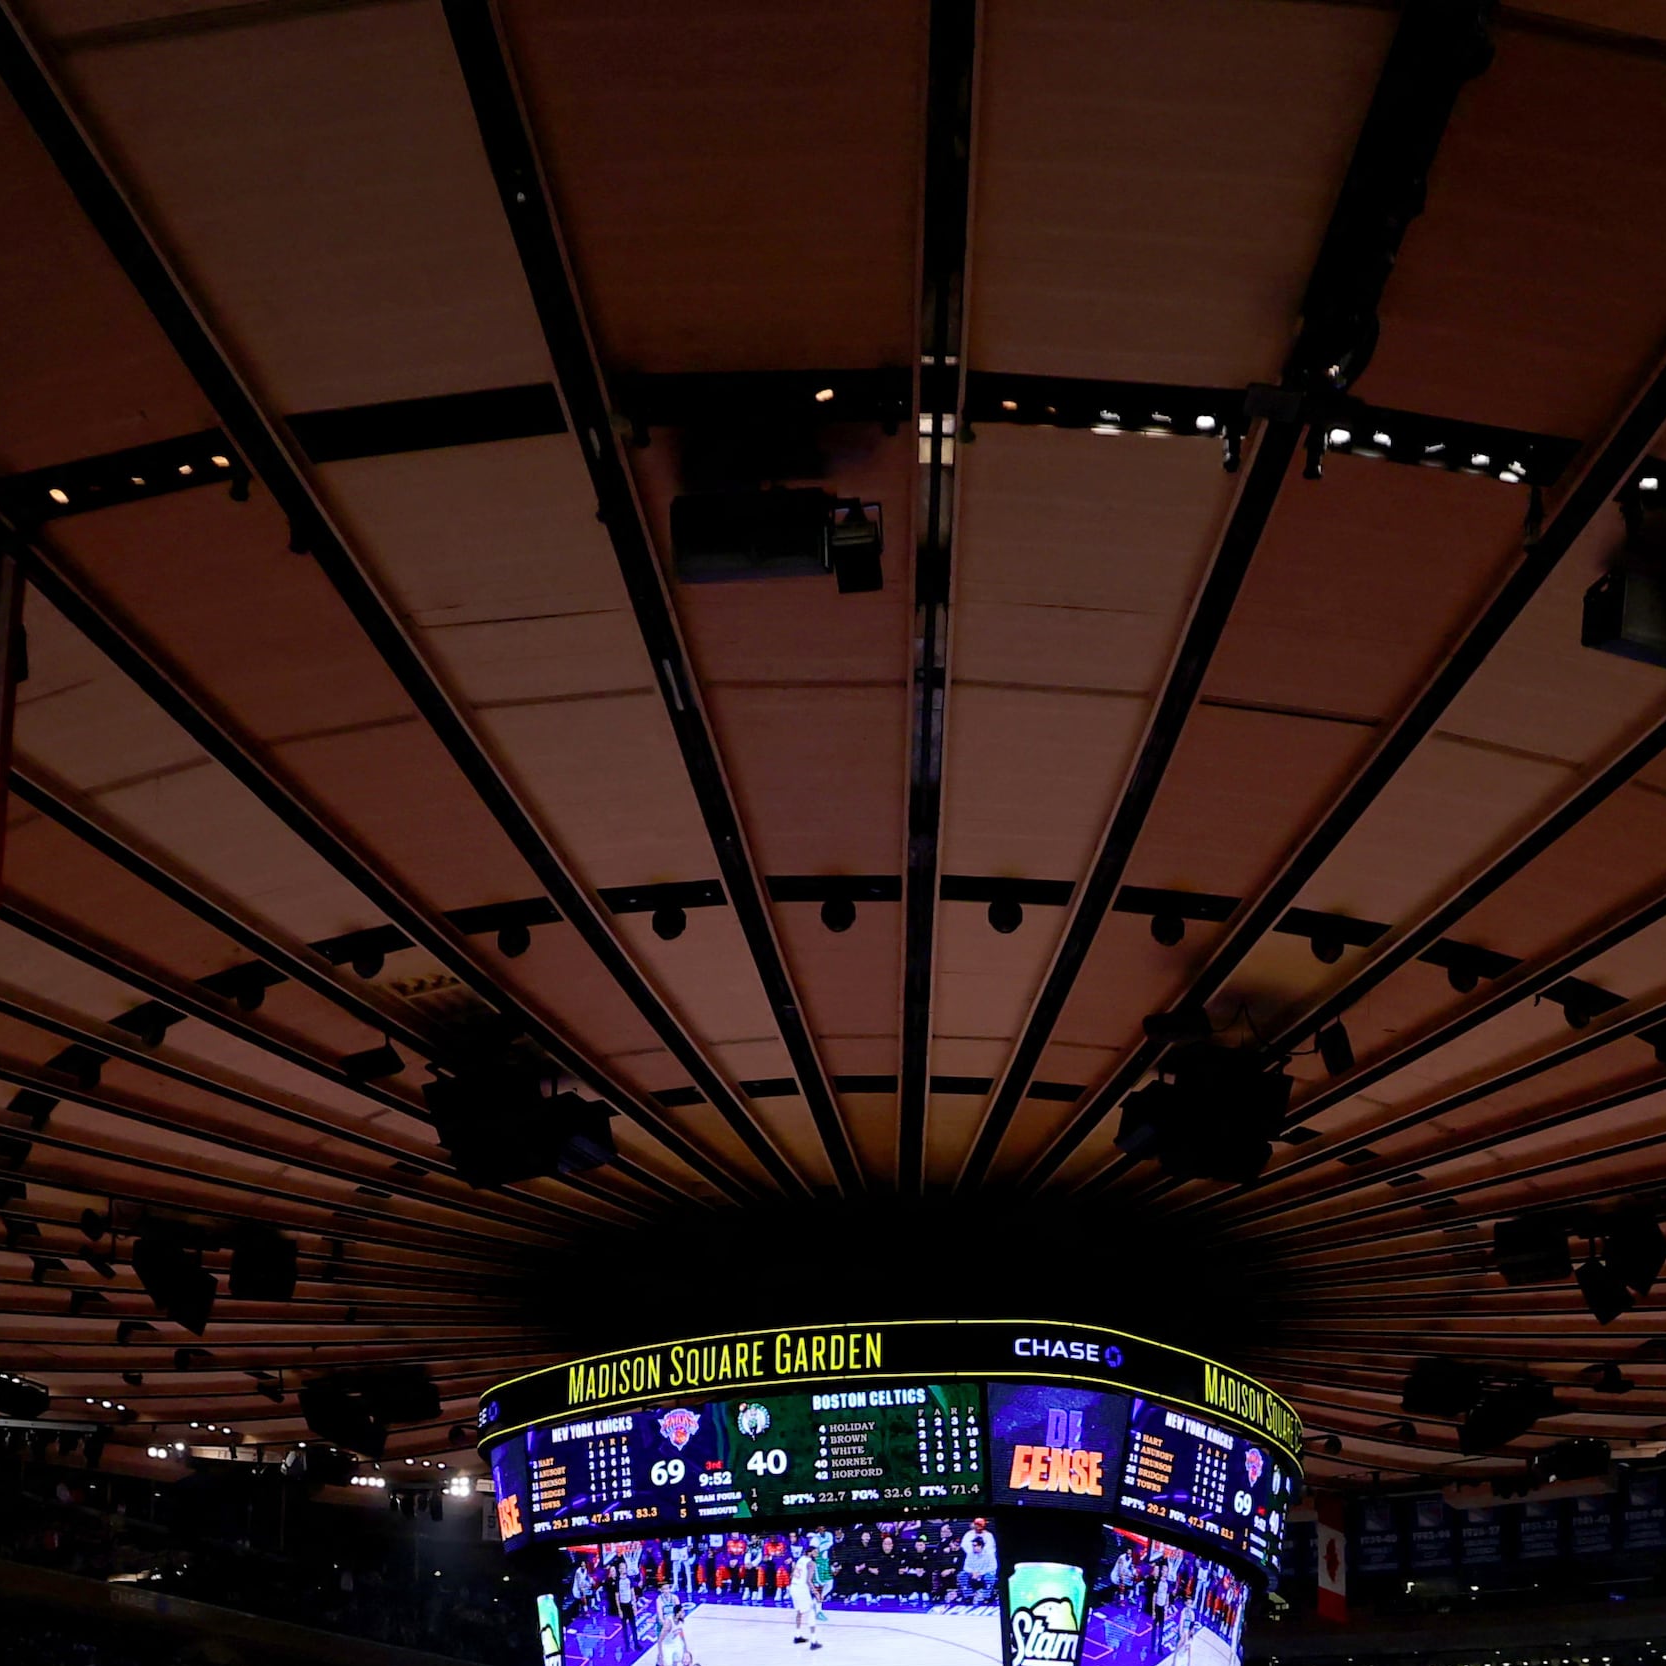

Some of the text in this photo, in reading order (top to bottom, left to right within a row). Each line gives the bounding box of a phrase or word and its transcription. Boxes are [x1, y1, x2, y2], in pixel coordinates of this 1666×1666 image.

[1015, 1338, 1100, 1362] CHASE
[568, 1332, 882, 1405] MADISON SQUARE GARDEN
[813, 1388, 926, 1411] BOSTON CELTICS
[1204, 1364, 1264, 1424] MADISON
[552, 1416, 633, 1443] NEW YORK KNICKS
[830, 1416, 975, 1433] HOLIDAY 2 2 3 4
[1046, 1408, 1082, 1449] DE
[1165, 1412, 1233, 1450] NEW YORK KNICKS
[830, 1434, 867, 1444] BROWN
[919, 1430, 926, 1439] 2
[935, 1429, 942, 1438] 4
[1143, 1434, 1163, 1447] HART
[831, 1440, 959, 1456] WHITE 2 1 1
[706, 1461, 723, 1470] 3rd
[747, 1449, 787, 1476] 40
[832, 1457, 874, 1467] KORNET
[920, 1453, 927, 1462] 2
[936, 1452, 944, 1461] 0
[651, 1459, 685, 1486] 69
[699, 1472, 732, 1486] 9:52
[833, 1468, 882, 1479] HORFORD
[921, 1465, 928, 1474] 1
[937, 1464, 945, 1472] 0
[954, 1463, 961, 1472] 2
[970, 1462, 978, 1471] 4
[1010, 1445, 1103, 1496] FENSE
[680, 1495, 686, 1504] 1
[694, 1494, 714, 1504] TEAM
[751, 1488, 757, 1497] 1
[783, 1484, 980, 1505] 3PT% 22.7 FG% 32.6 FT% 71.4
[1234, 1490, 1252, 1516] 69
[591, 1512, 610, 1524] 47.3
[636, 1507, 657, 1518] 83.3
[679, 1503, 758, 1518] 5 TIMEOUTS 4
[1121, 1496, 1145, 1511] 3PT%
[1147, 1503, 1166, 1517] 29.2
